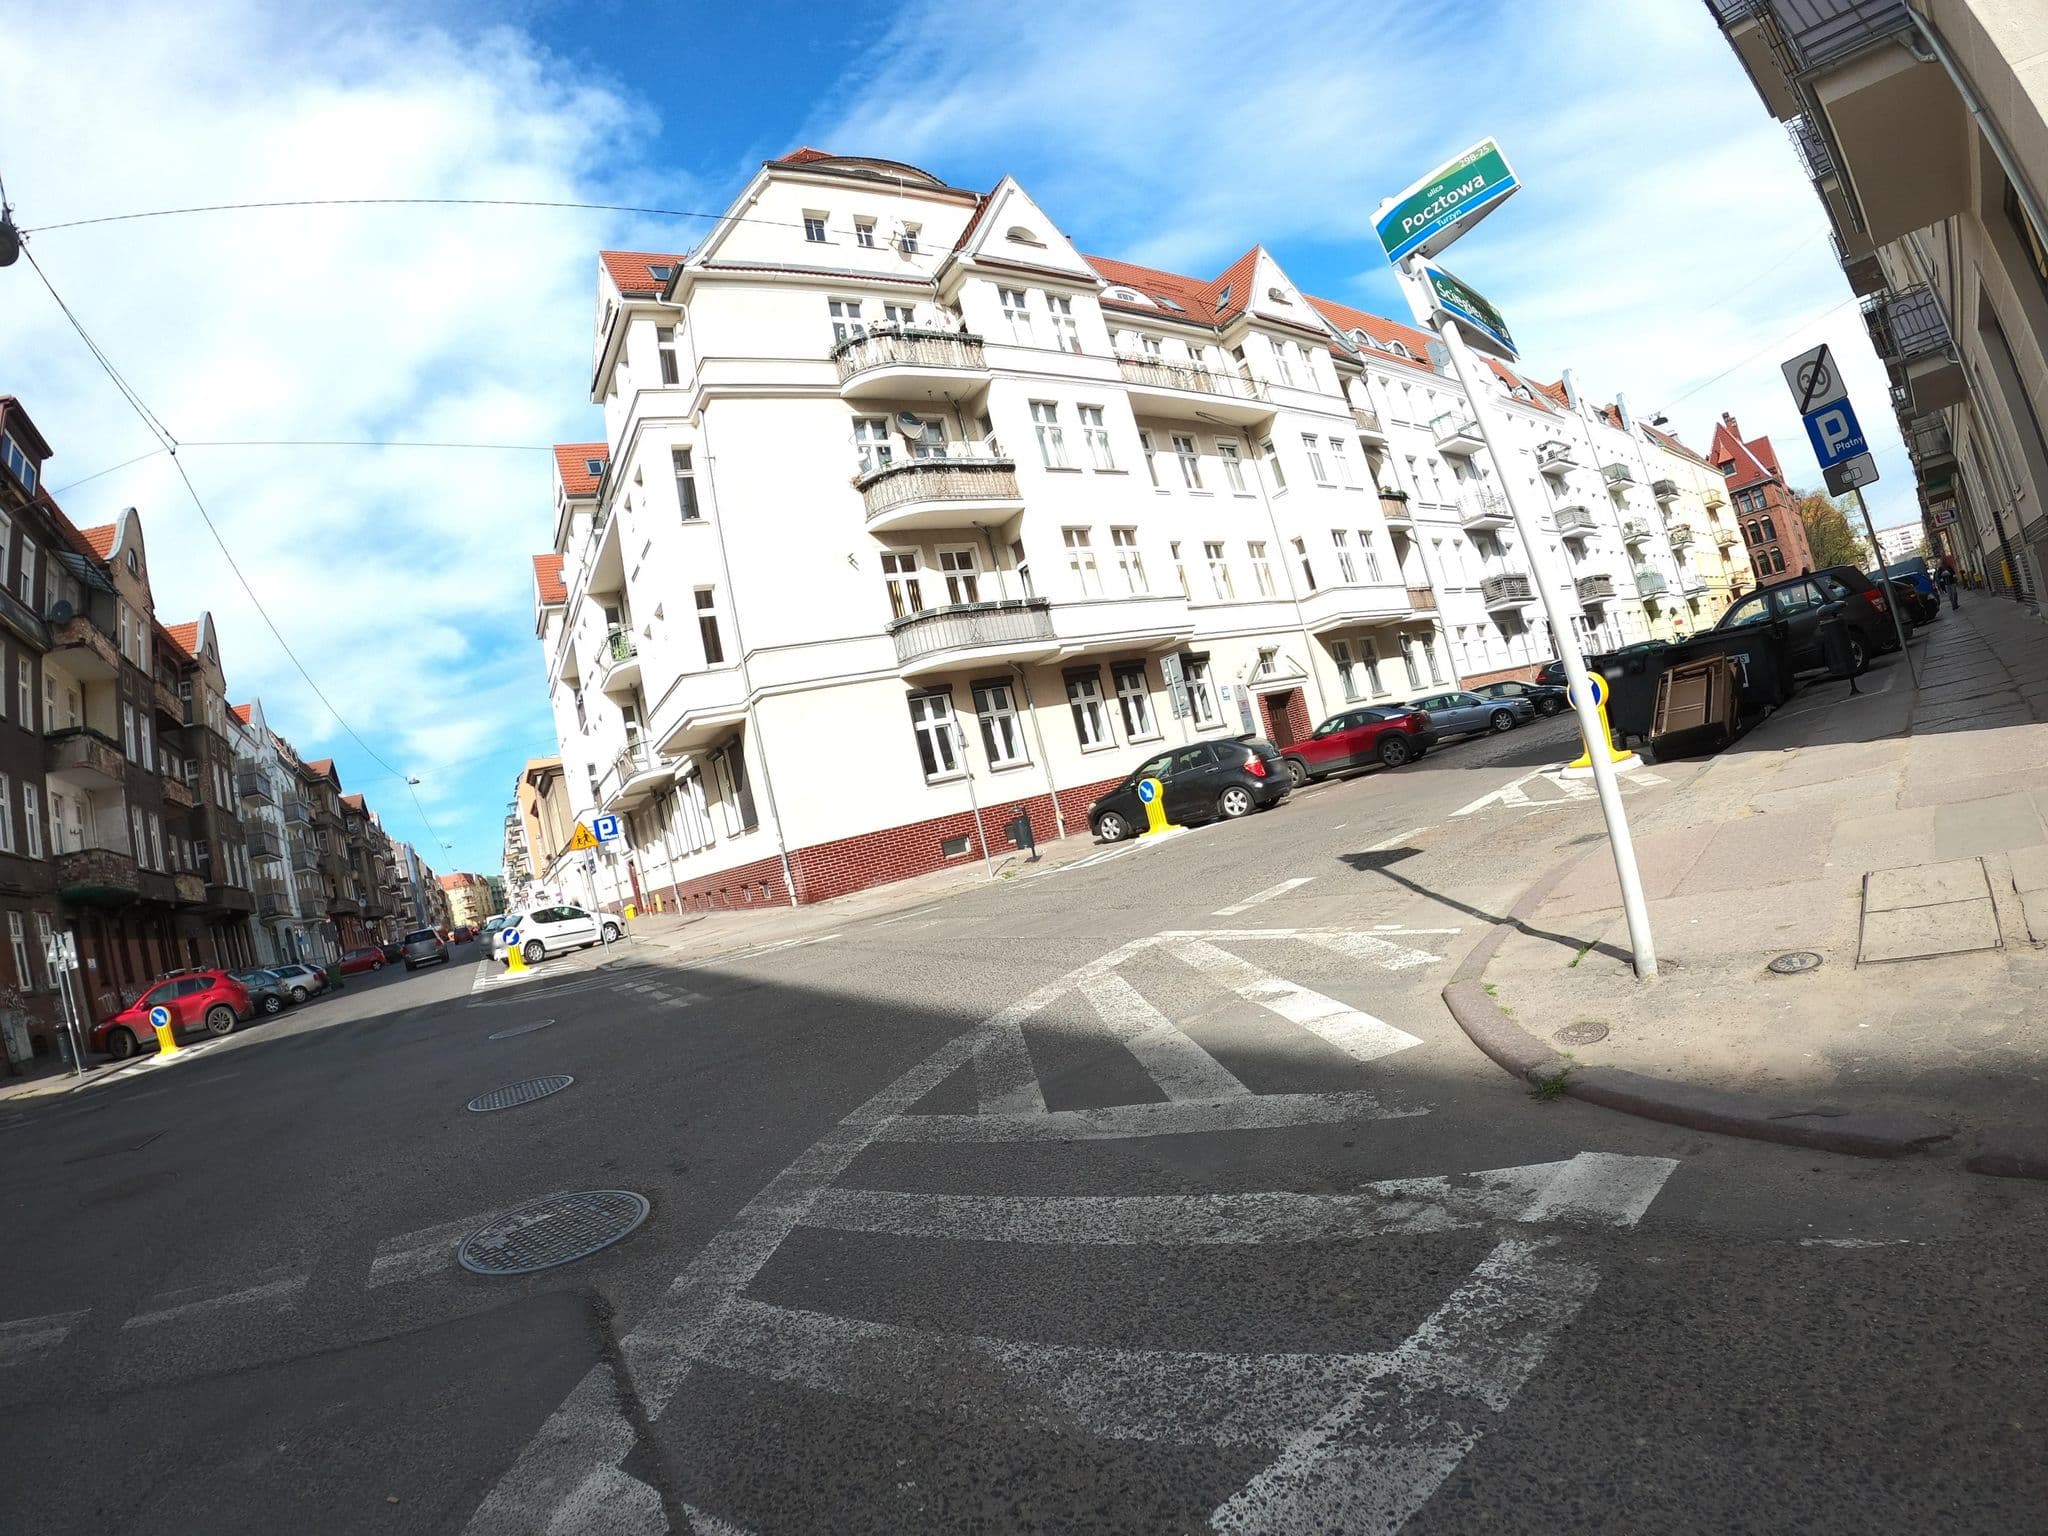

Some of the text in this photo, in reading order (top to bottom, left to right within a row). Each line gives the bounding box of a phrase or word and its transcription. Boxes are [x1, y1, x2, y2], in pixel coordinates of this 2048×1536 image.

[1427, 185, 1444, 197] ulica
[1402, 175, 1485, 233] Pocztowa
[1436, 209, 1462, 227] Turzyn
[1815, 410, 1849, 457] P
[598, 819, 613, 840] P
